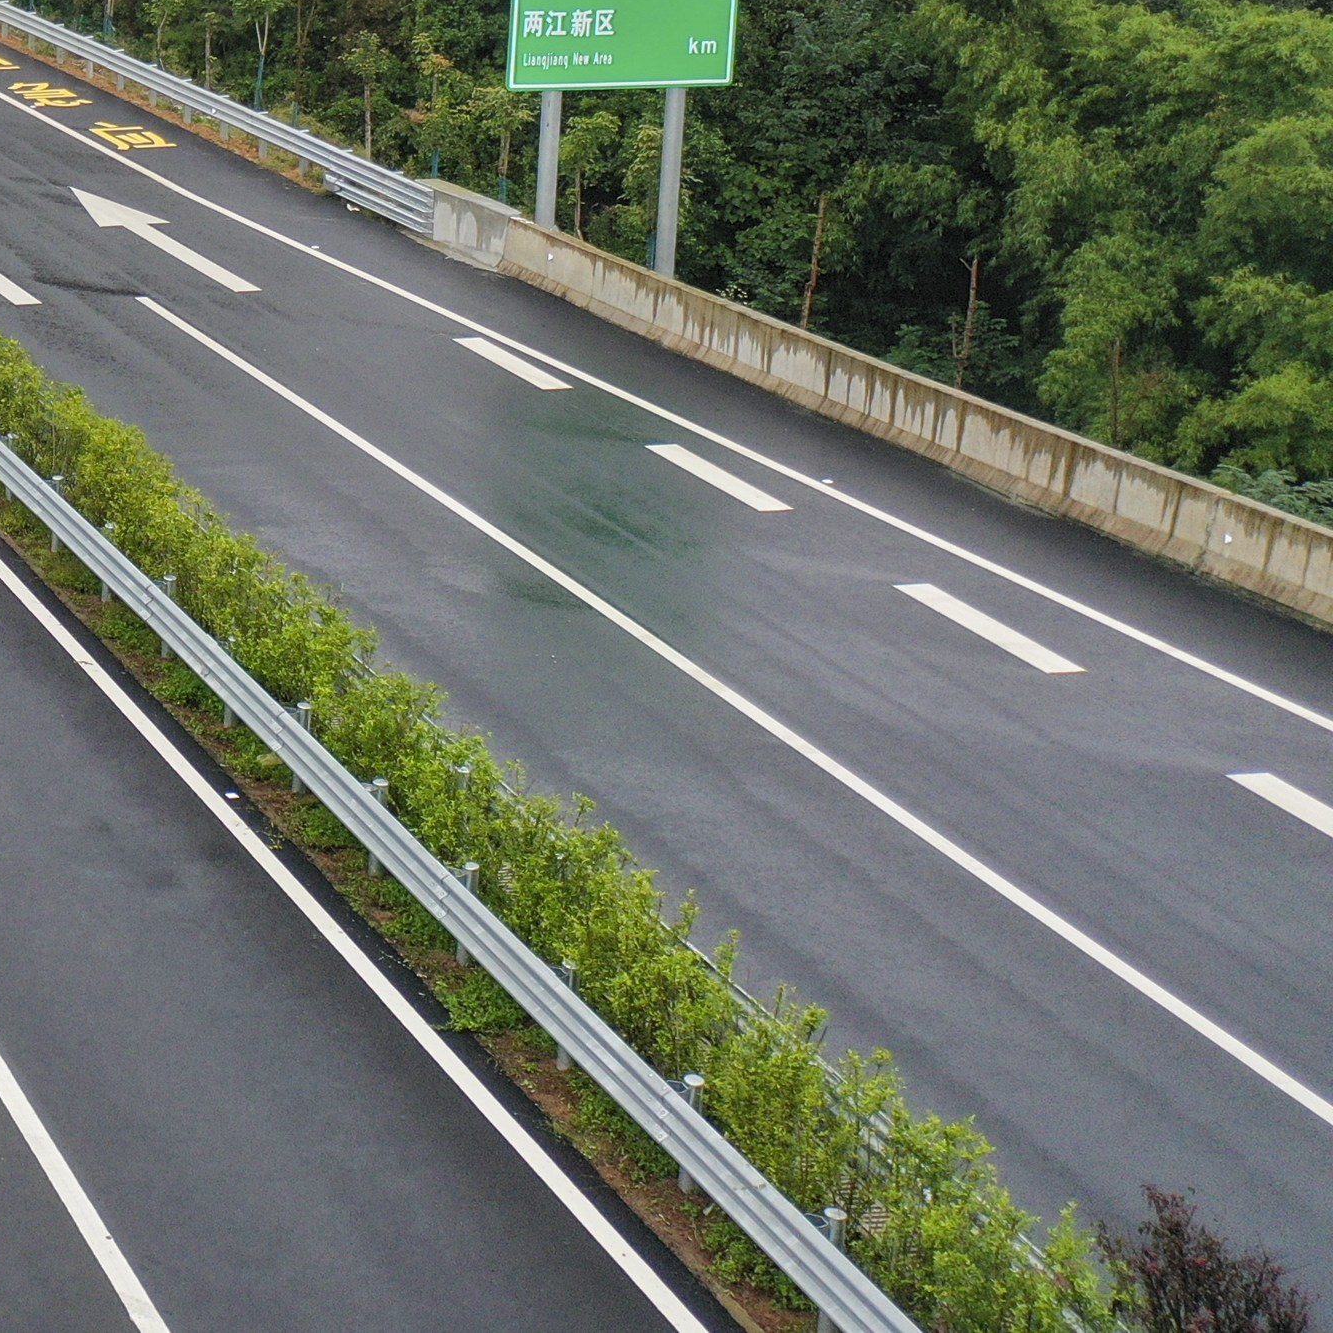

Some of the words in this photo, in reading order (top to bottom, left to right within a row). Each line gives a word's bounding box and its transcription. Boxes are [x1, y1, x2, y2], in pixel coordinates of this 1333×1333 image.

[522, 9, 616, 38] 两江新区
[688, 37, 718, 55] km
[522, 53, 569, 70] Liangjiang
[572, 52, 590, 66] New
[592, 52, 614, 66] Area
